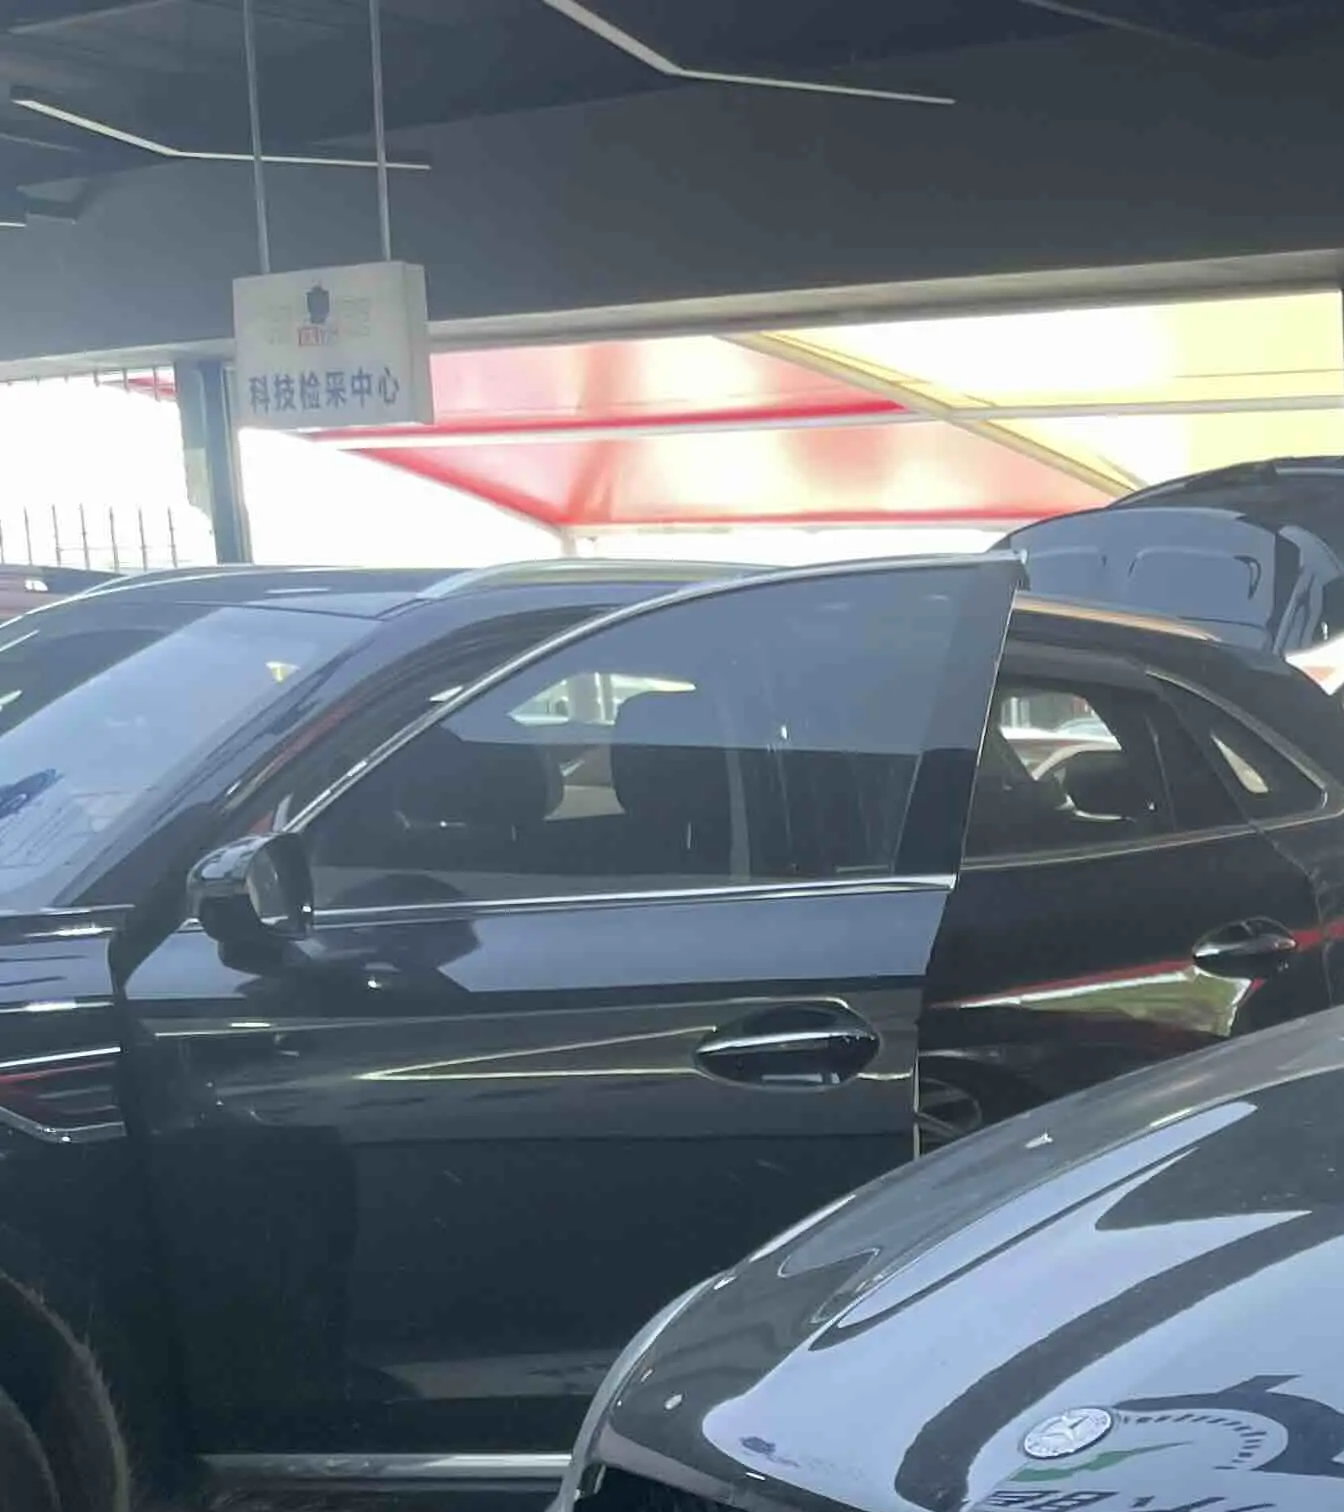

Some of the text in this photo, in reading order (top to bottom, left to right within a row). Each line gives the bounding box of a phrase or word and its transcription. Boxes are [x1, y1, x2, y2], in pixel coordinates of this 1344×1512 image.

[248, 367, 399, 414] 科技检采中心
